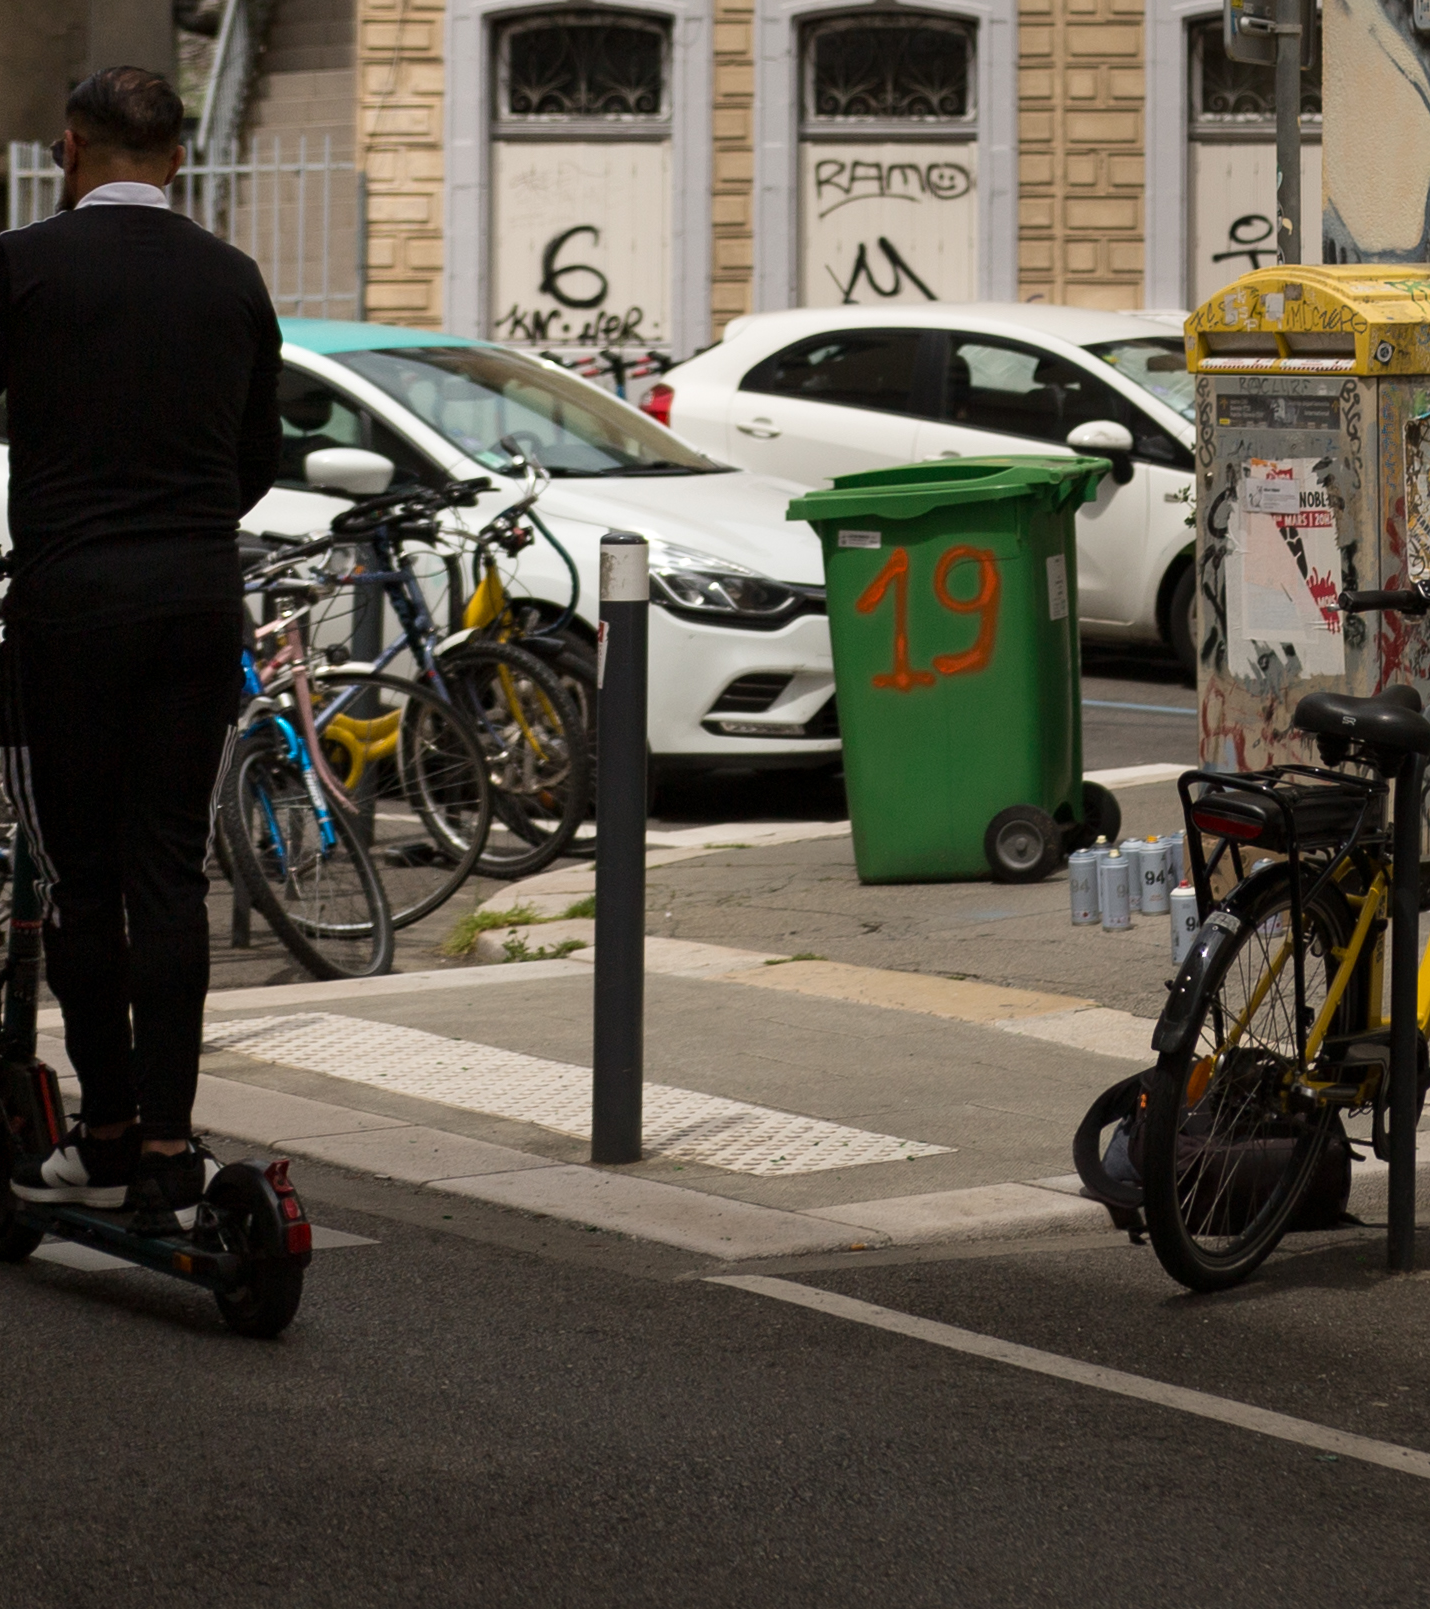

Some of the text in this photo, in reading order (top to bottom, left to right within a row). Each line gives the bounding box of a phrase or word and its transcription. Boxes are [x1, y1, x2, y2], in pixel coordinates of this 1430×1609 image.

[855, 546, 1002, 695] 19
[1145, 870, 1166, 886] 94
[1185, 917, 1200, 932] 9
